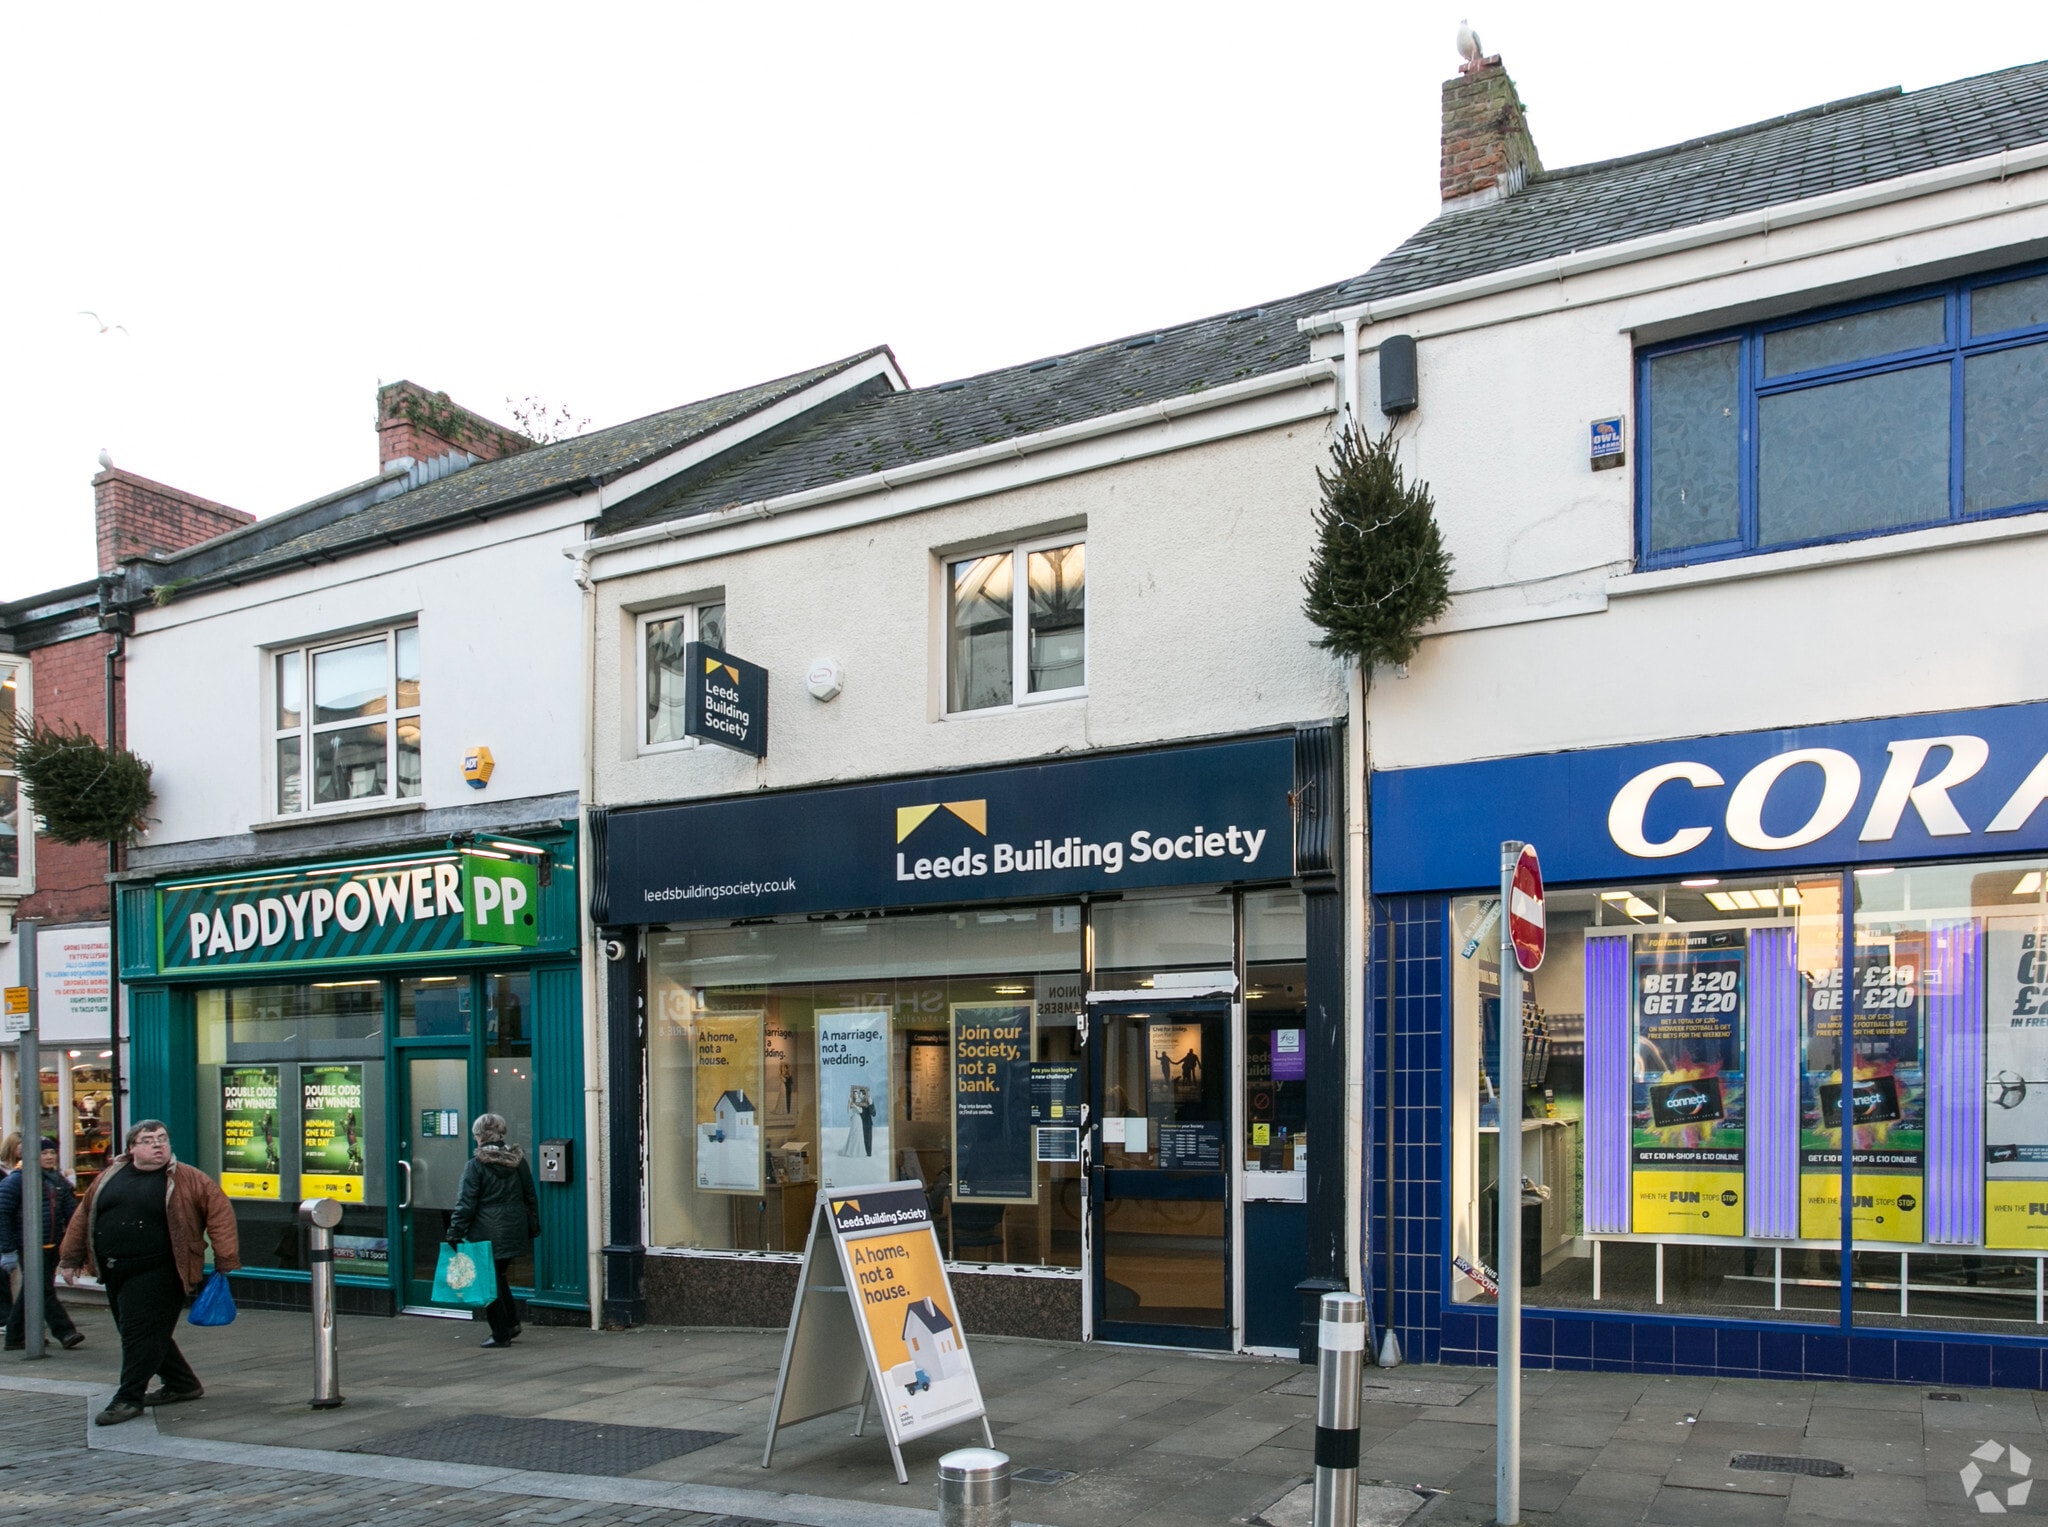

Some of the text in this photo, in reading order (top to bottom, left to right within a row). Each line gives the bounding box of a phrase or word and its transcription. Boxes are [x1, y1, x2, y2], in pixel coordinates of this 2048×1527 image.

[705, 679, 739, 703] Leeds
[705, 695, 750, 726] Building
[705, 712, 748, 741] Society
[896, 825, 1267, 881] Leeds Building Society
[644, 877, 796, 902] leedsbuildingsociety.co.uk
[1648, 939, 1686, 947] FOOTBALL
[1687, 937, 1707, 945] WITH
[2017, 950, 2048, 985] G
[1644, 971, 1737, 994] BET £20
[1863, 965, 1914, 988] £20
[1644, 992, 1737, 1015] GET £20
[1863, 987, 1914, 1009] £20
[2011, 1018, 2023, 1027] IN
[700, 1032, 706, 1042] A
[707, 1031, 738, 1043] home,
[822, 1029, 882, 1042] A marriage,
[958, 1024, 990, 1040] Join
[993, 1027, 1022, 1039] our
[700, 1045, 721, 1054] not a
[822, 1044, 839, 1053] not
[958, 1041, 1021, 1061] Society,
[700, 1056, 730, 1065] house.
[822, 1053, 869, 1067] wedding.
[958, 1060, 996, 1075] not a
[305, 1085, 361, 1096] DOUBLE ODDS
[958, 1076, 1000, 1092] bank.
[225, 1087, 277, 1097] DOUBLE ODDS
[226, 1098, 277, 1110] ANY WINNER
[305, 1097, 361, 1109] ANY WINNER
[1666, 1093, 1707, 1108] connect
[1837, 1093, 1881, 1108] cnnect
[305, 1120, 335, 1128] MINIMUM
[239, 1129, 254, 1137] RACE
[305, 1129, 335, 1137] ONE RACE
[226, 1138, 248, 1146] PER DAY
[305, 1138, 330, 1146] PER DAY
[1640, 1152, 1653, 1160] GET
[1667, 1152, 1695, 1160] IN-SHOP
[1715, 1153, 1739, 1161] ONLINE
[1891, 1156, 1917, 1164] ONLINE
[1669, 1191, 1700, 1203] FUN
[1722, 1194, 1737, 1202] STOP
[1827, 1197, 1838, 1205] THE
[1842, 1196, 1873, 1208] UN
[837, 1208, 926, 1229] Leeds Building Society
[855, 1245, 910, 1265] A home,
[1456, 1258, 1471, 1272] sky
[859, 1266, 894, 1285] not a
[864, 1284, 910, 1305] house.
